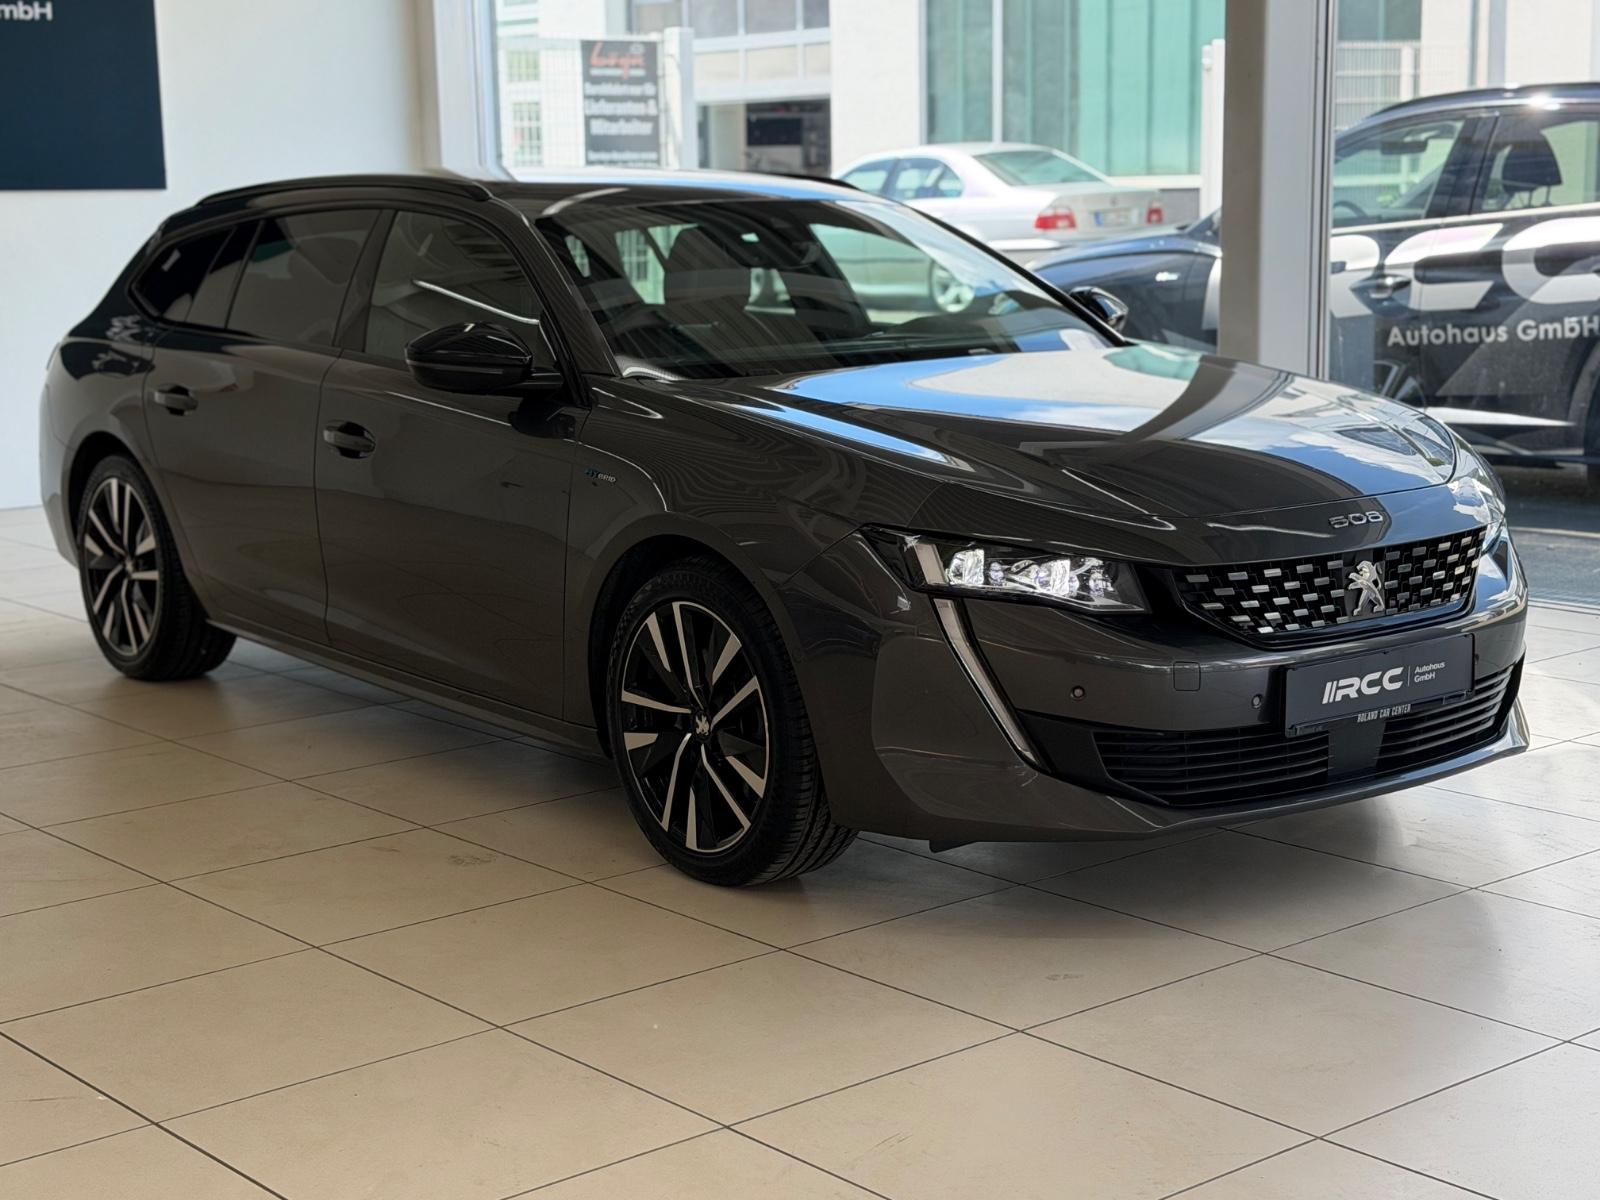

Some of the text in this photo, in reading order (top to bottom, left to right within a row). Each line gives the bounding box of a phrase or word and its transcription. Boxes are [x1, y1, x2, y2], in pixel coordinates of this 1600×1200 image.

[1387, 315, 1600, 347] Autohaus GmbH
[1329, 511, 1383, 529] 508
[1414, 662, 1445, 674] Autohaus
[1414, 672, 1436, 683] GmbH
[1357, 704, 1411, 723] ROLAND CAR CENTER
